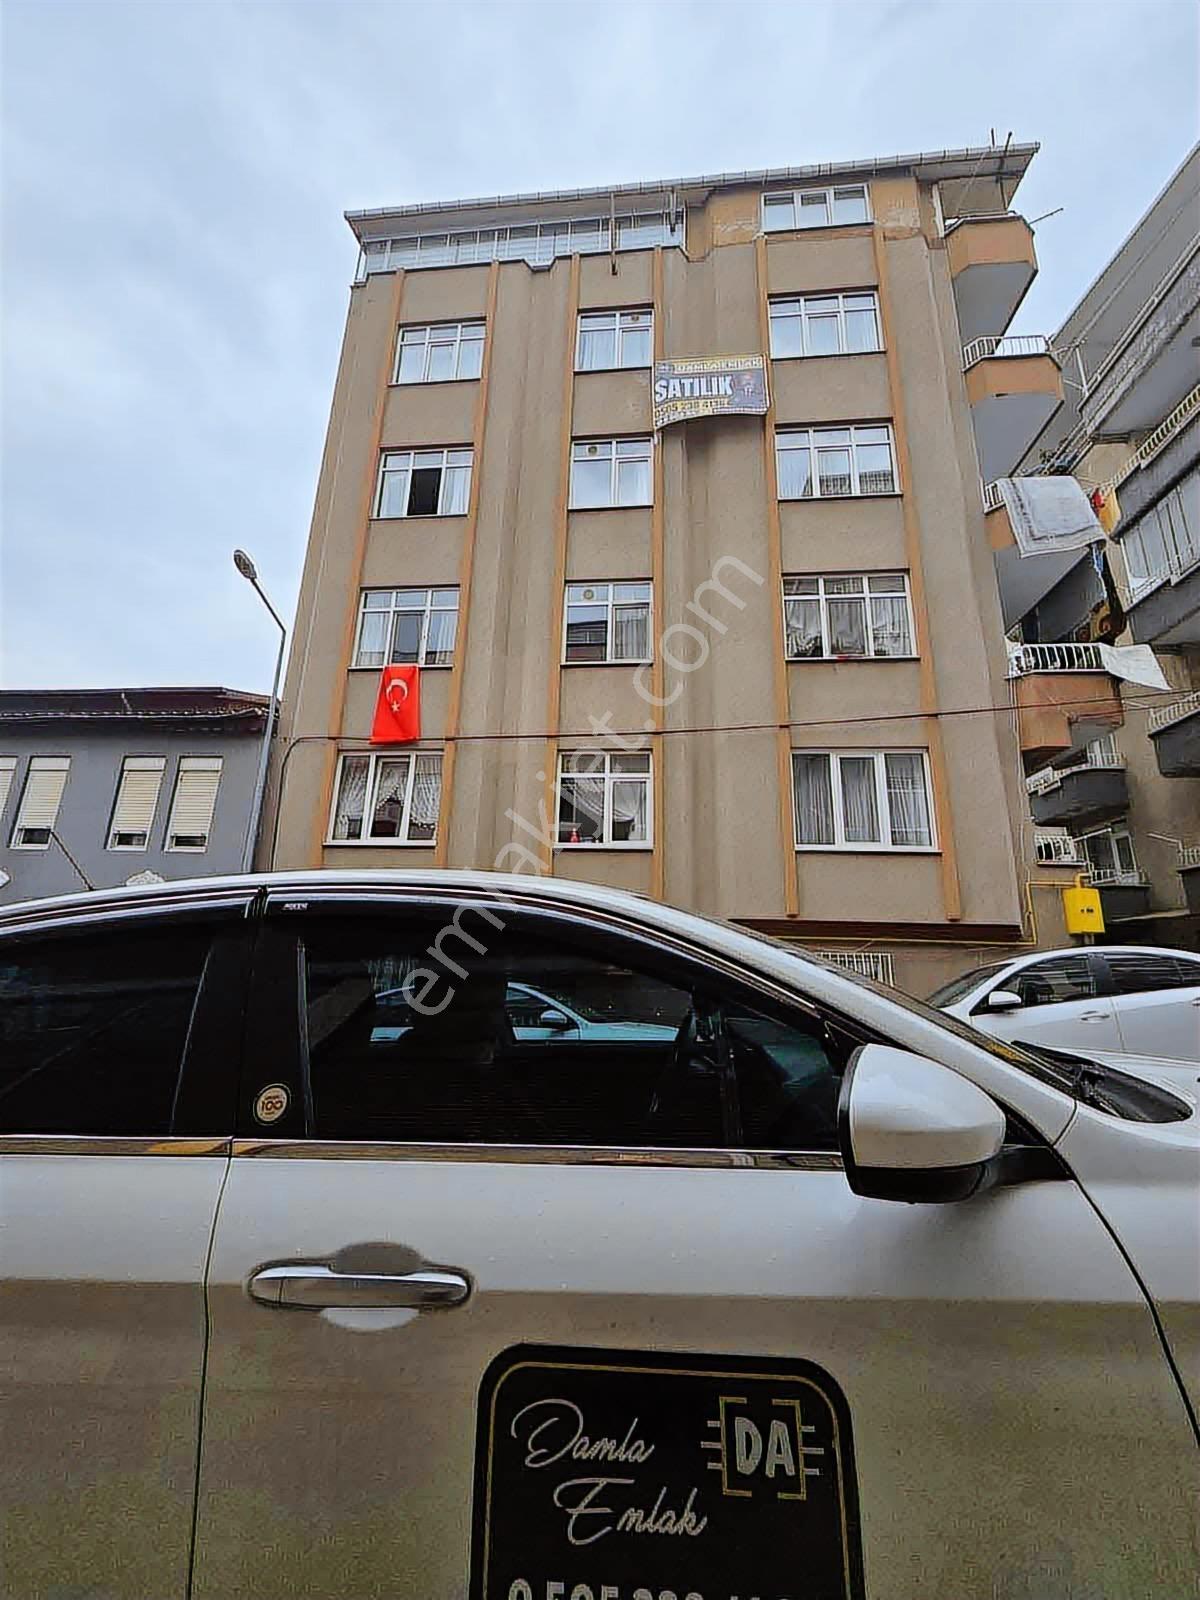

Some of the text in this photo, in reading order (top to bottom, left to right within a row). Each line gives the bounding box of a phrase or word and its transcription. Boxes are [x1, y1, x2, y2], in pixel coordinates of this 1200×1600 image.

[655, 375, 733, 403] SATILIK
[511, 1398, 655, 1467] Damla
[734, 1416, 795, 1478] DA
[553, 1477, 708, 1545] Emlak
